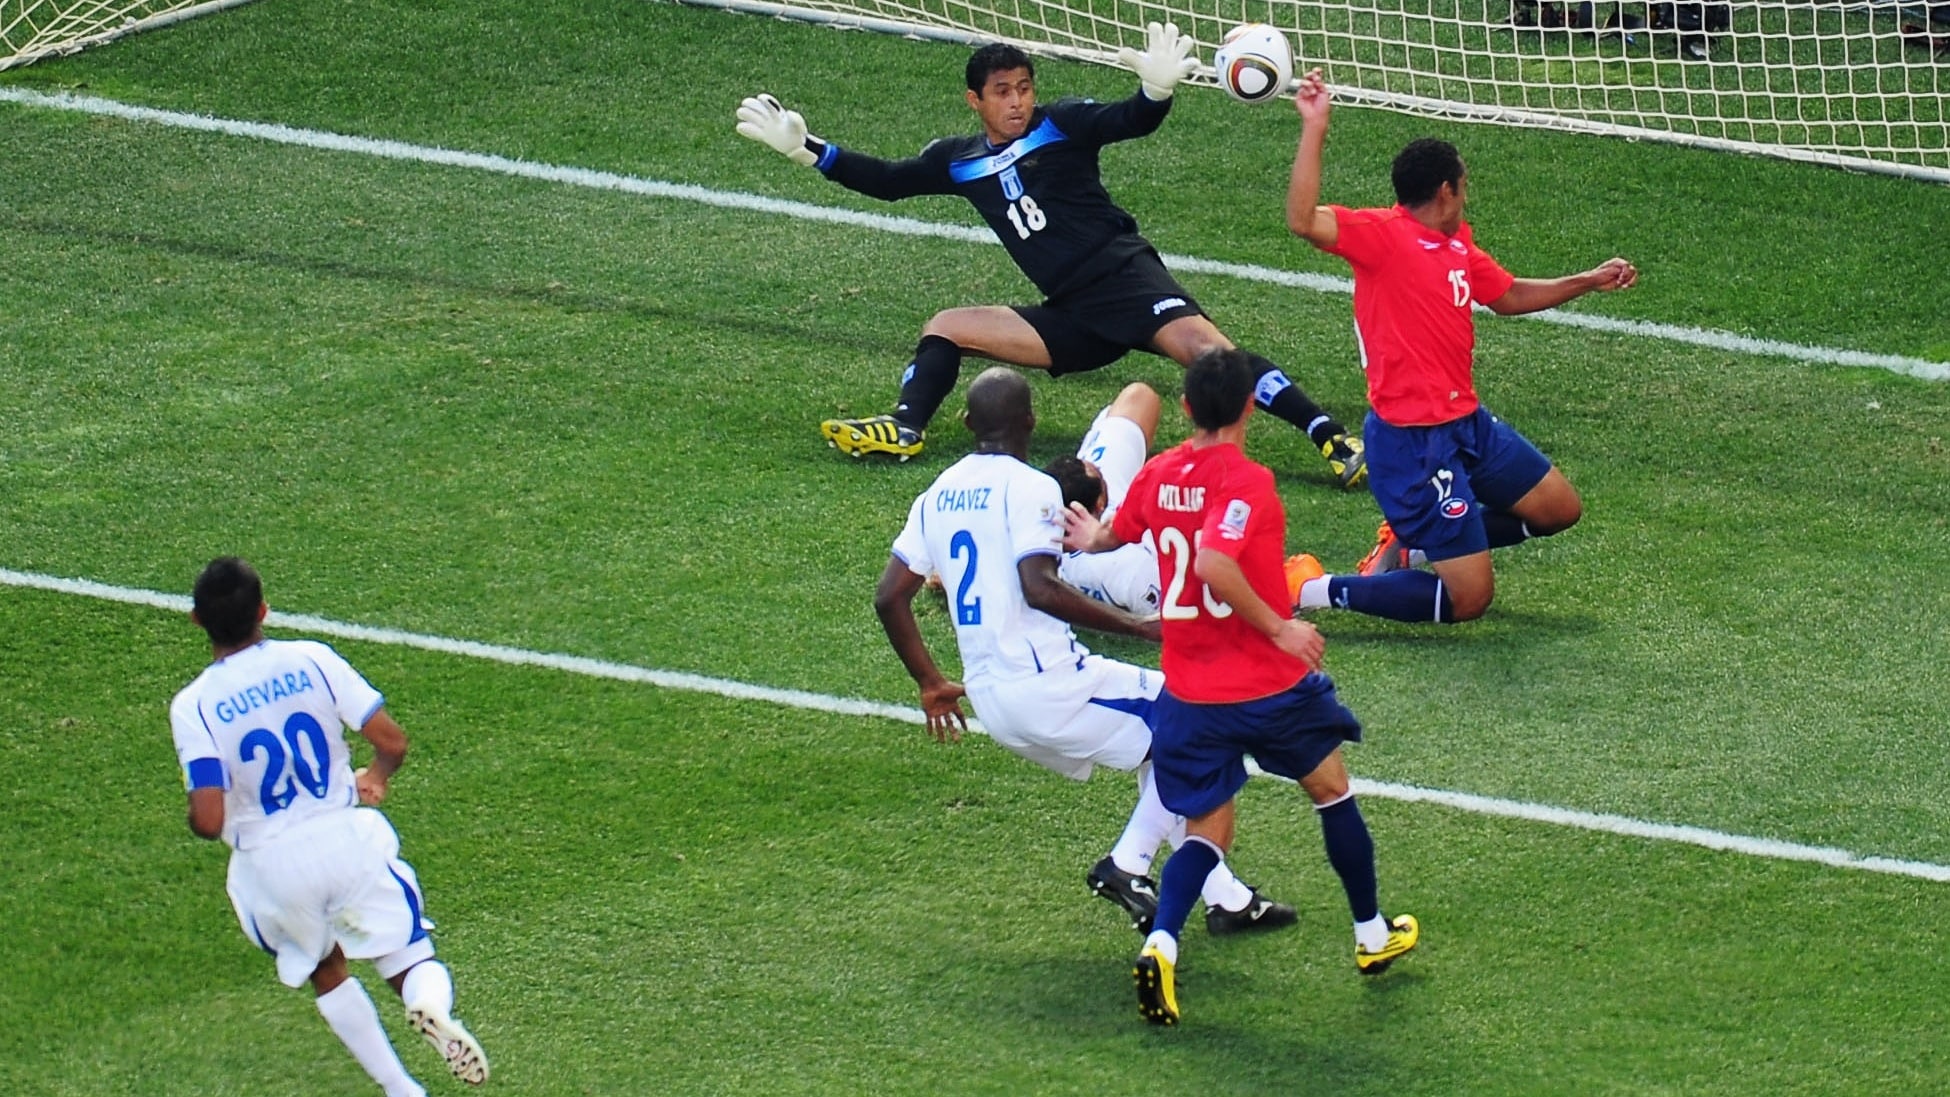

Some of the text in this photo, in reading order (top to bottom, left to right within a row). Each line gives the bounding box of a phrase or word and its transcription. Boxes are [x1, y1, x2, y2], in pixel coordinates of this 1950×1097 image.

[1006, 195, 1047, 240] 18
[1447, 269, 1470, 307] 15
[937, 488, 991, 512] CHAVEZ
[950, 529, 981, 625] 2
[216, 670, 312, 724] GUEVARA
[240, 711, 331, 815] 20
